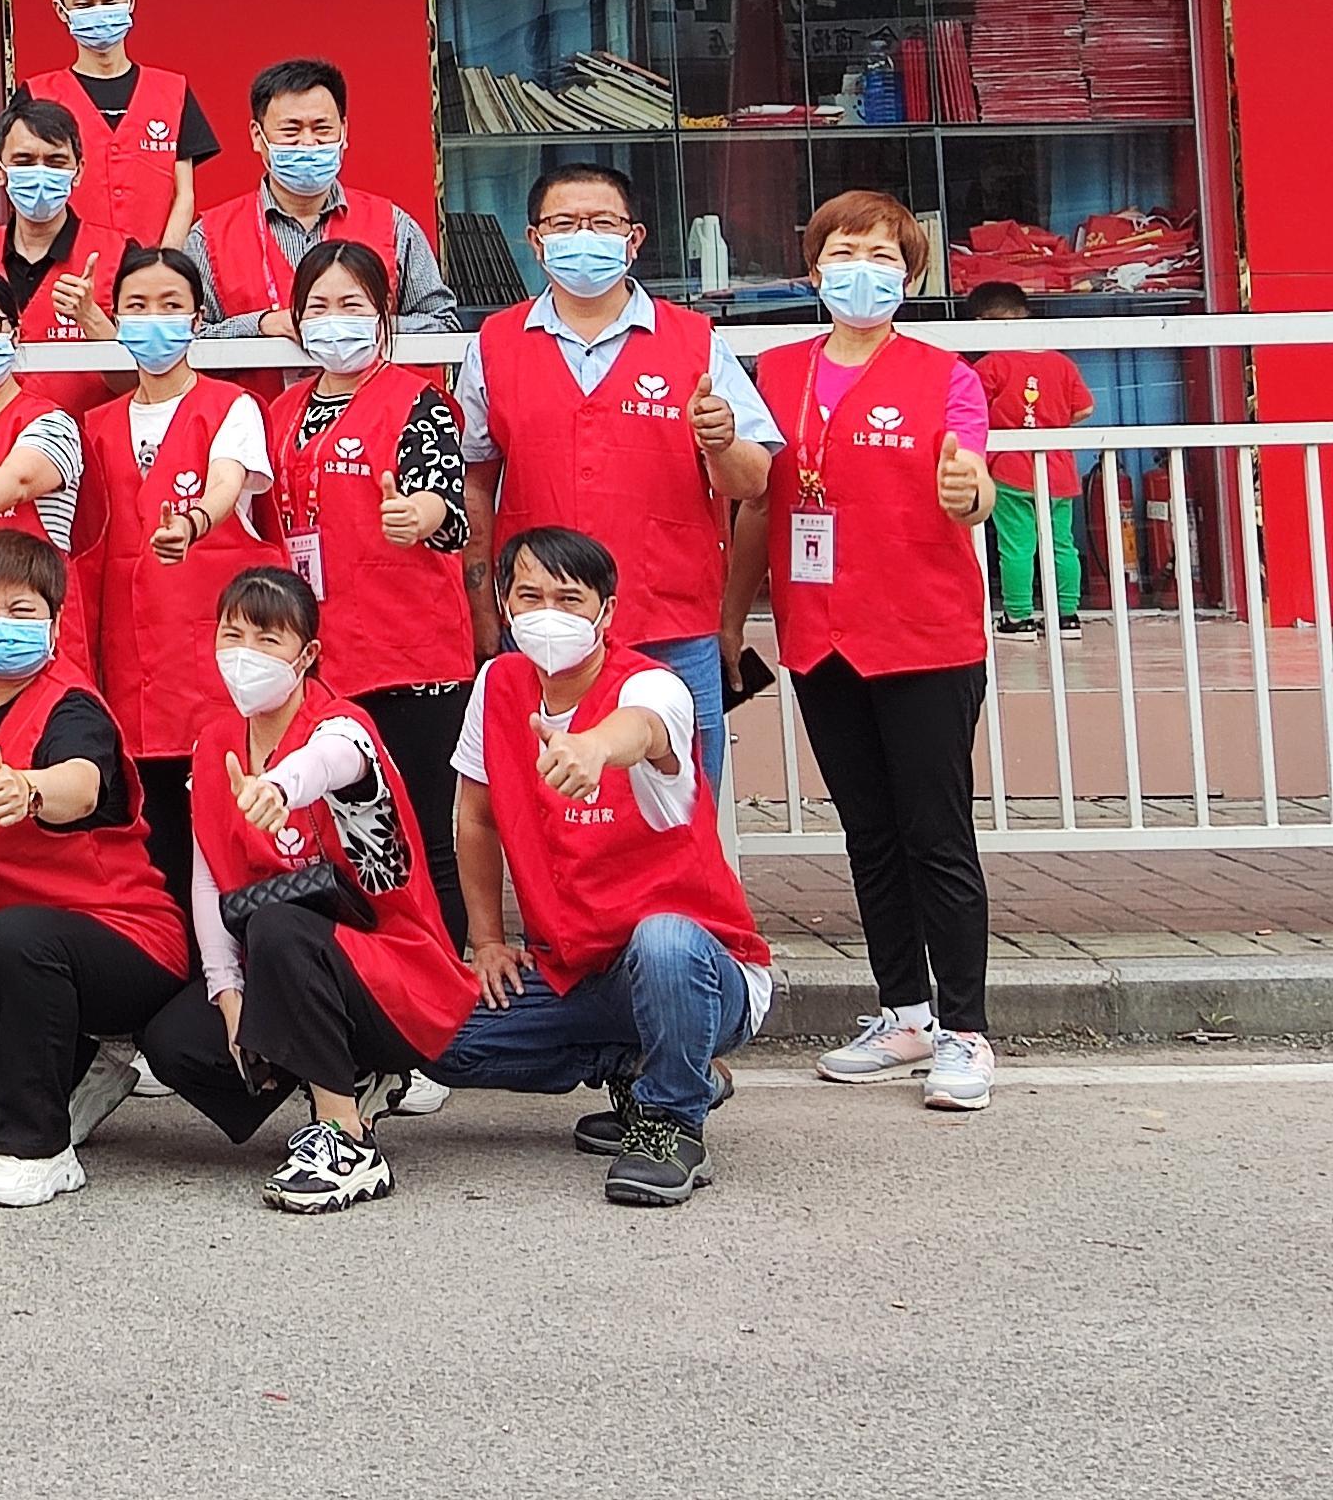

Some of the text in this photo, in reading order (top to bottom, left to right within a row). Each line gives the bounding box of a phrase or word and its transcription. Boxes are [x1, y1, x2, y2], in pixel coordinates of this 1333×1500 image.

[621, 399, 681, 421] 让爱回家
[852, 431, 916, 450] 让爱回家
[324, 461, 372, 477] 让爱回家
